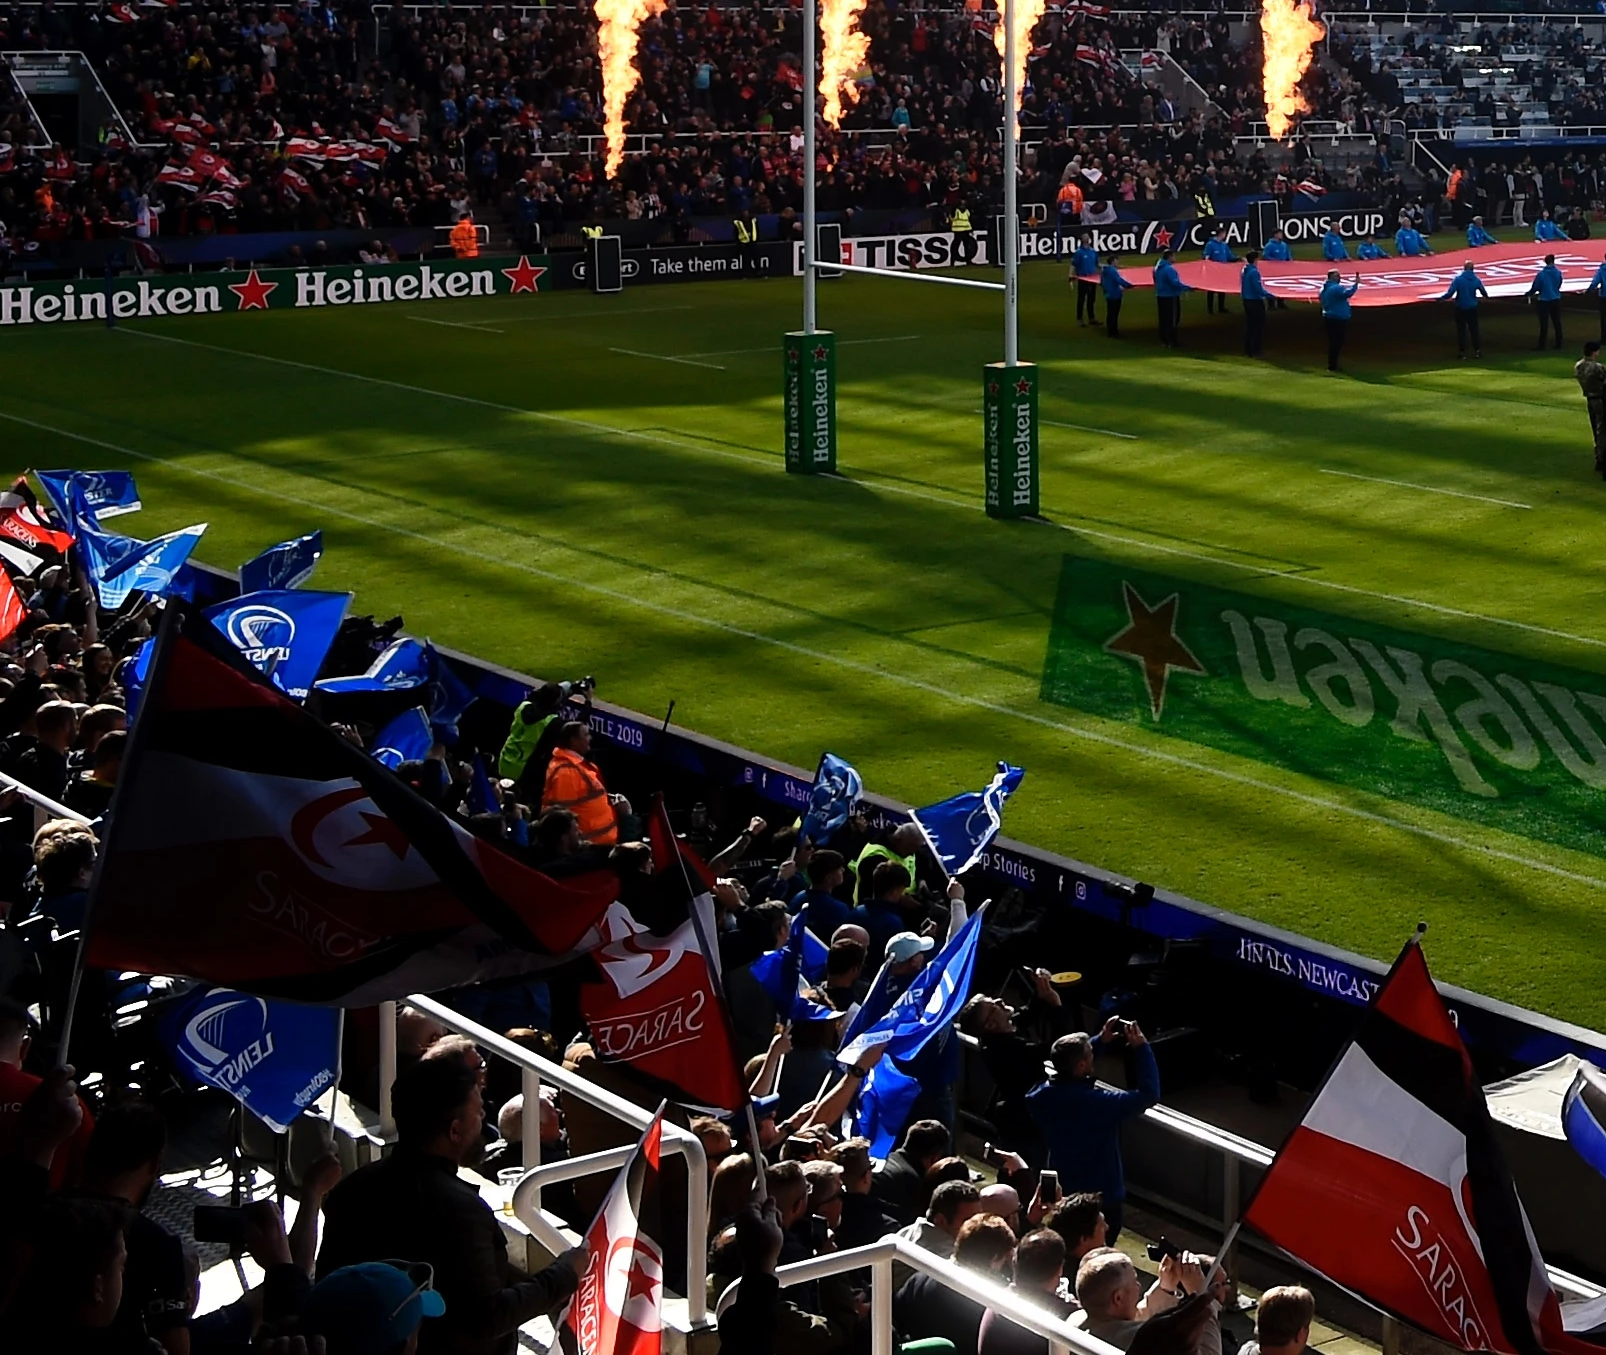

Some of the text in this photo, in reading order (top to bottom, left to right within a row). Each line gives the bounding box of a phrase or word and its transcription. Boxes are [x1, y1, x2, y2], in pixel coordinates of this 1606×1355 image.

[651, 257, 684, 275] Take
[688, 256, 723, 273] them
[726, 254, 744, 271] al
[1019, 225, 1137, 257] Heinken
[1339, 213, 1384, 236] CUP
[0, 266, 497, 325] Heineken Heineken
[812, 367, 829, 463] Heineken
[1013, 402, 1031, 506] Heineken
[617, 724, 643, 747] 2019
[993, 855, 1036, 883] Stories
[1237, 937, 1381, 1002] FINALS NEWCAST
[1396, 1205, 1480, 1351] SARAC
